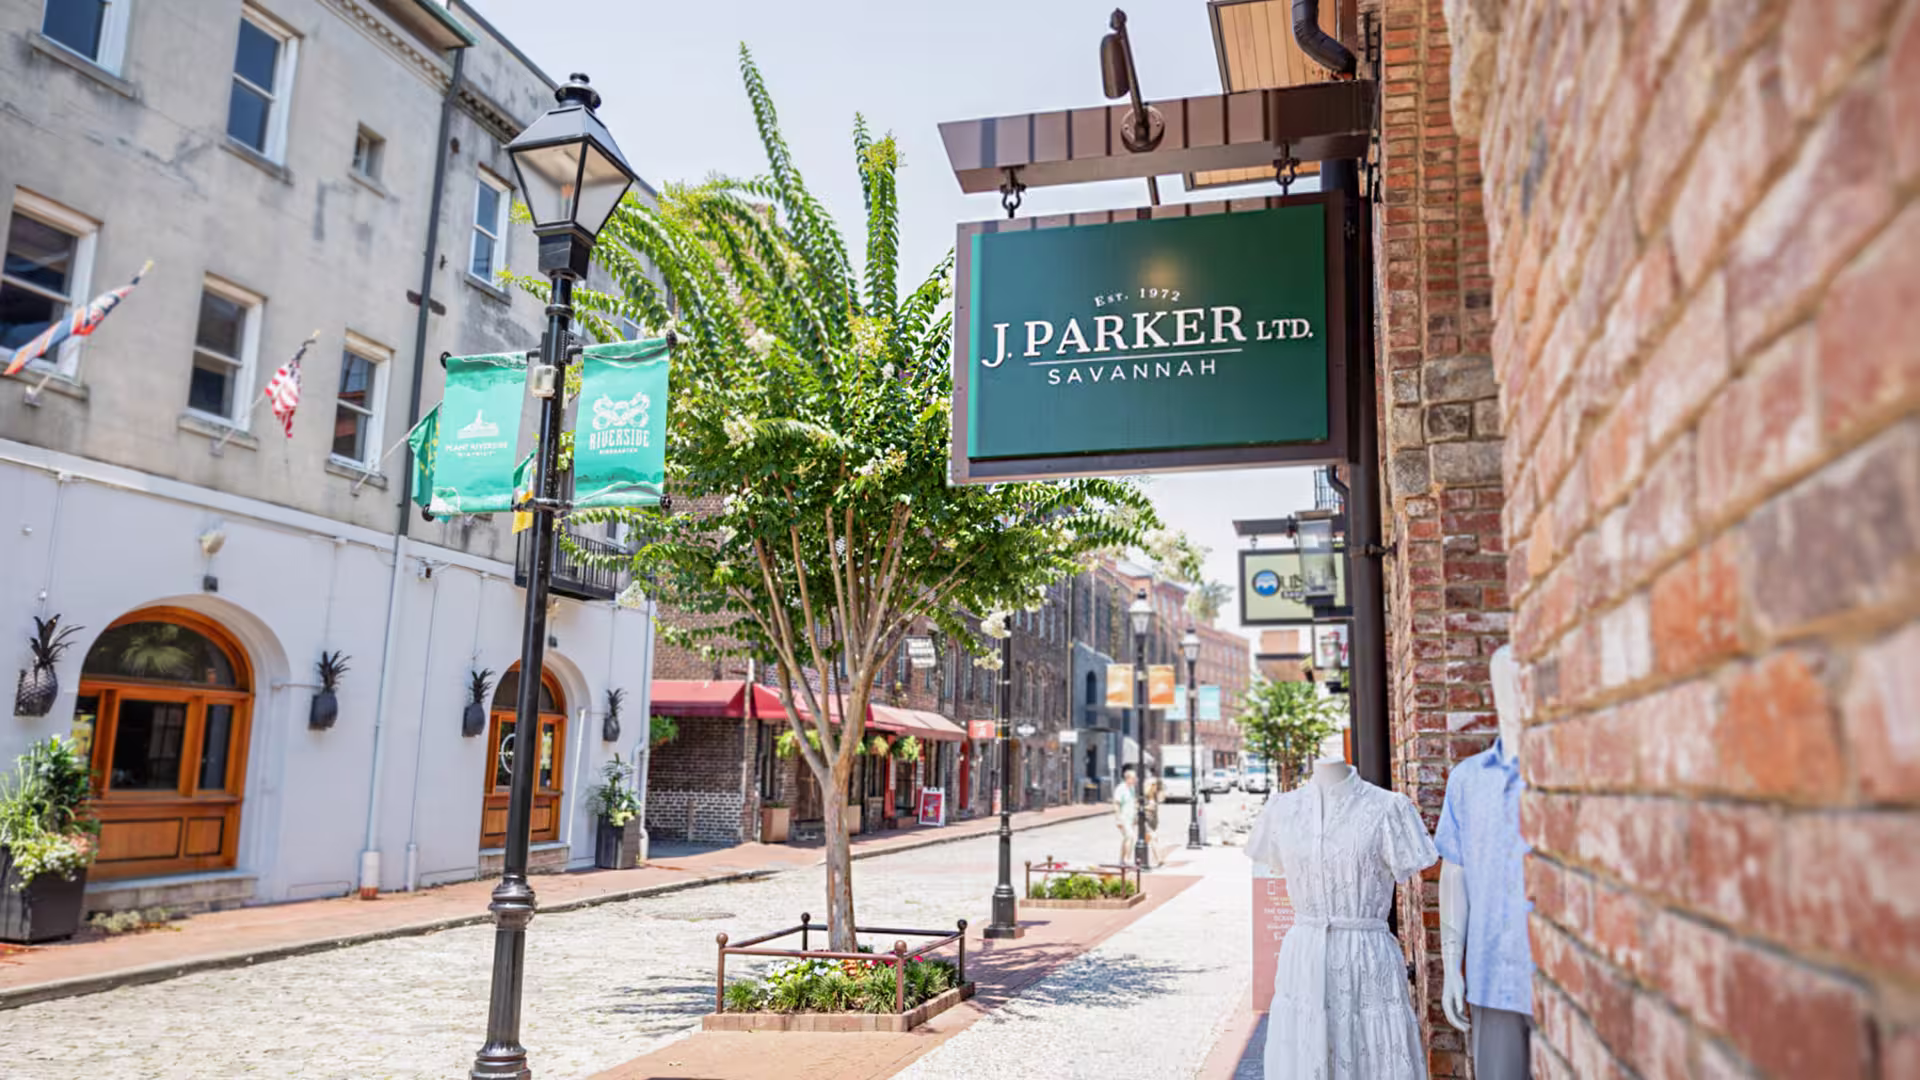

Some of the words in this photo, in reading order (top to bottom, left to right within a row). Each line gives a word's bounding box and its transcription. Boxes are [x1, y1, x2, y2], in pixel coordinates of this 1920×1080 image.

[1140, 288, 1181, 302] 1972
[981, 322, 1013, 368] J.
[1023, 305, 1247, 358] PARKER
[1257, 319, 1314, 341] LTD.
[1048, 359, 1216, 385] SAVANNAH
[589, 428, 650, 450] RIVERSIDE
